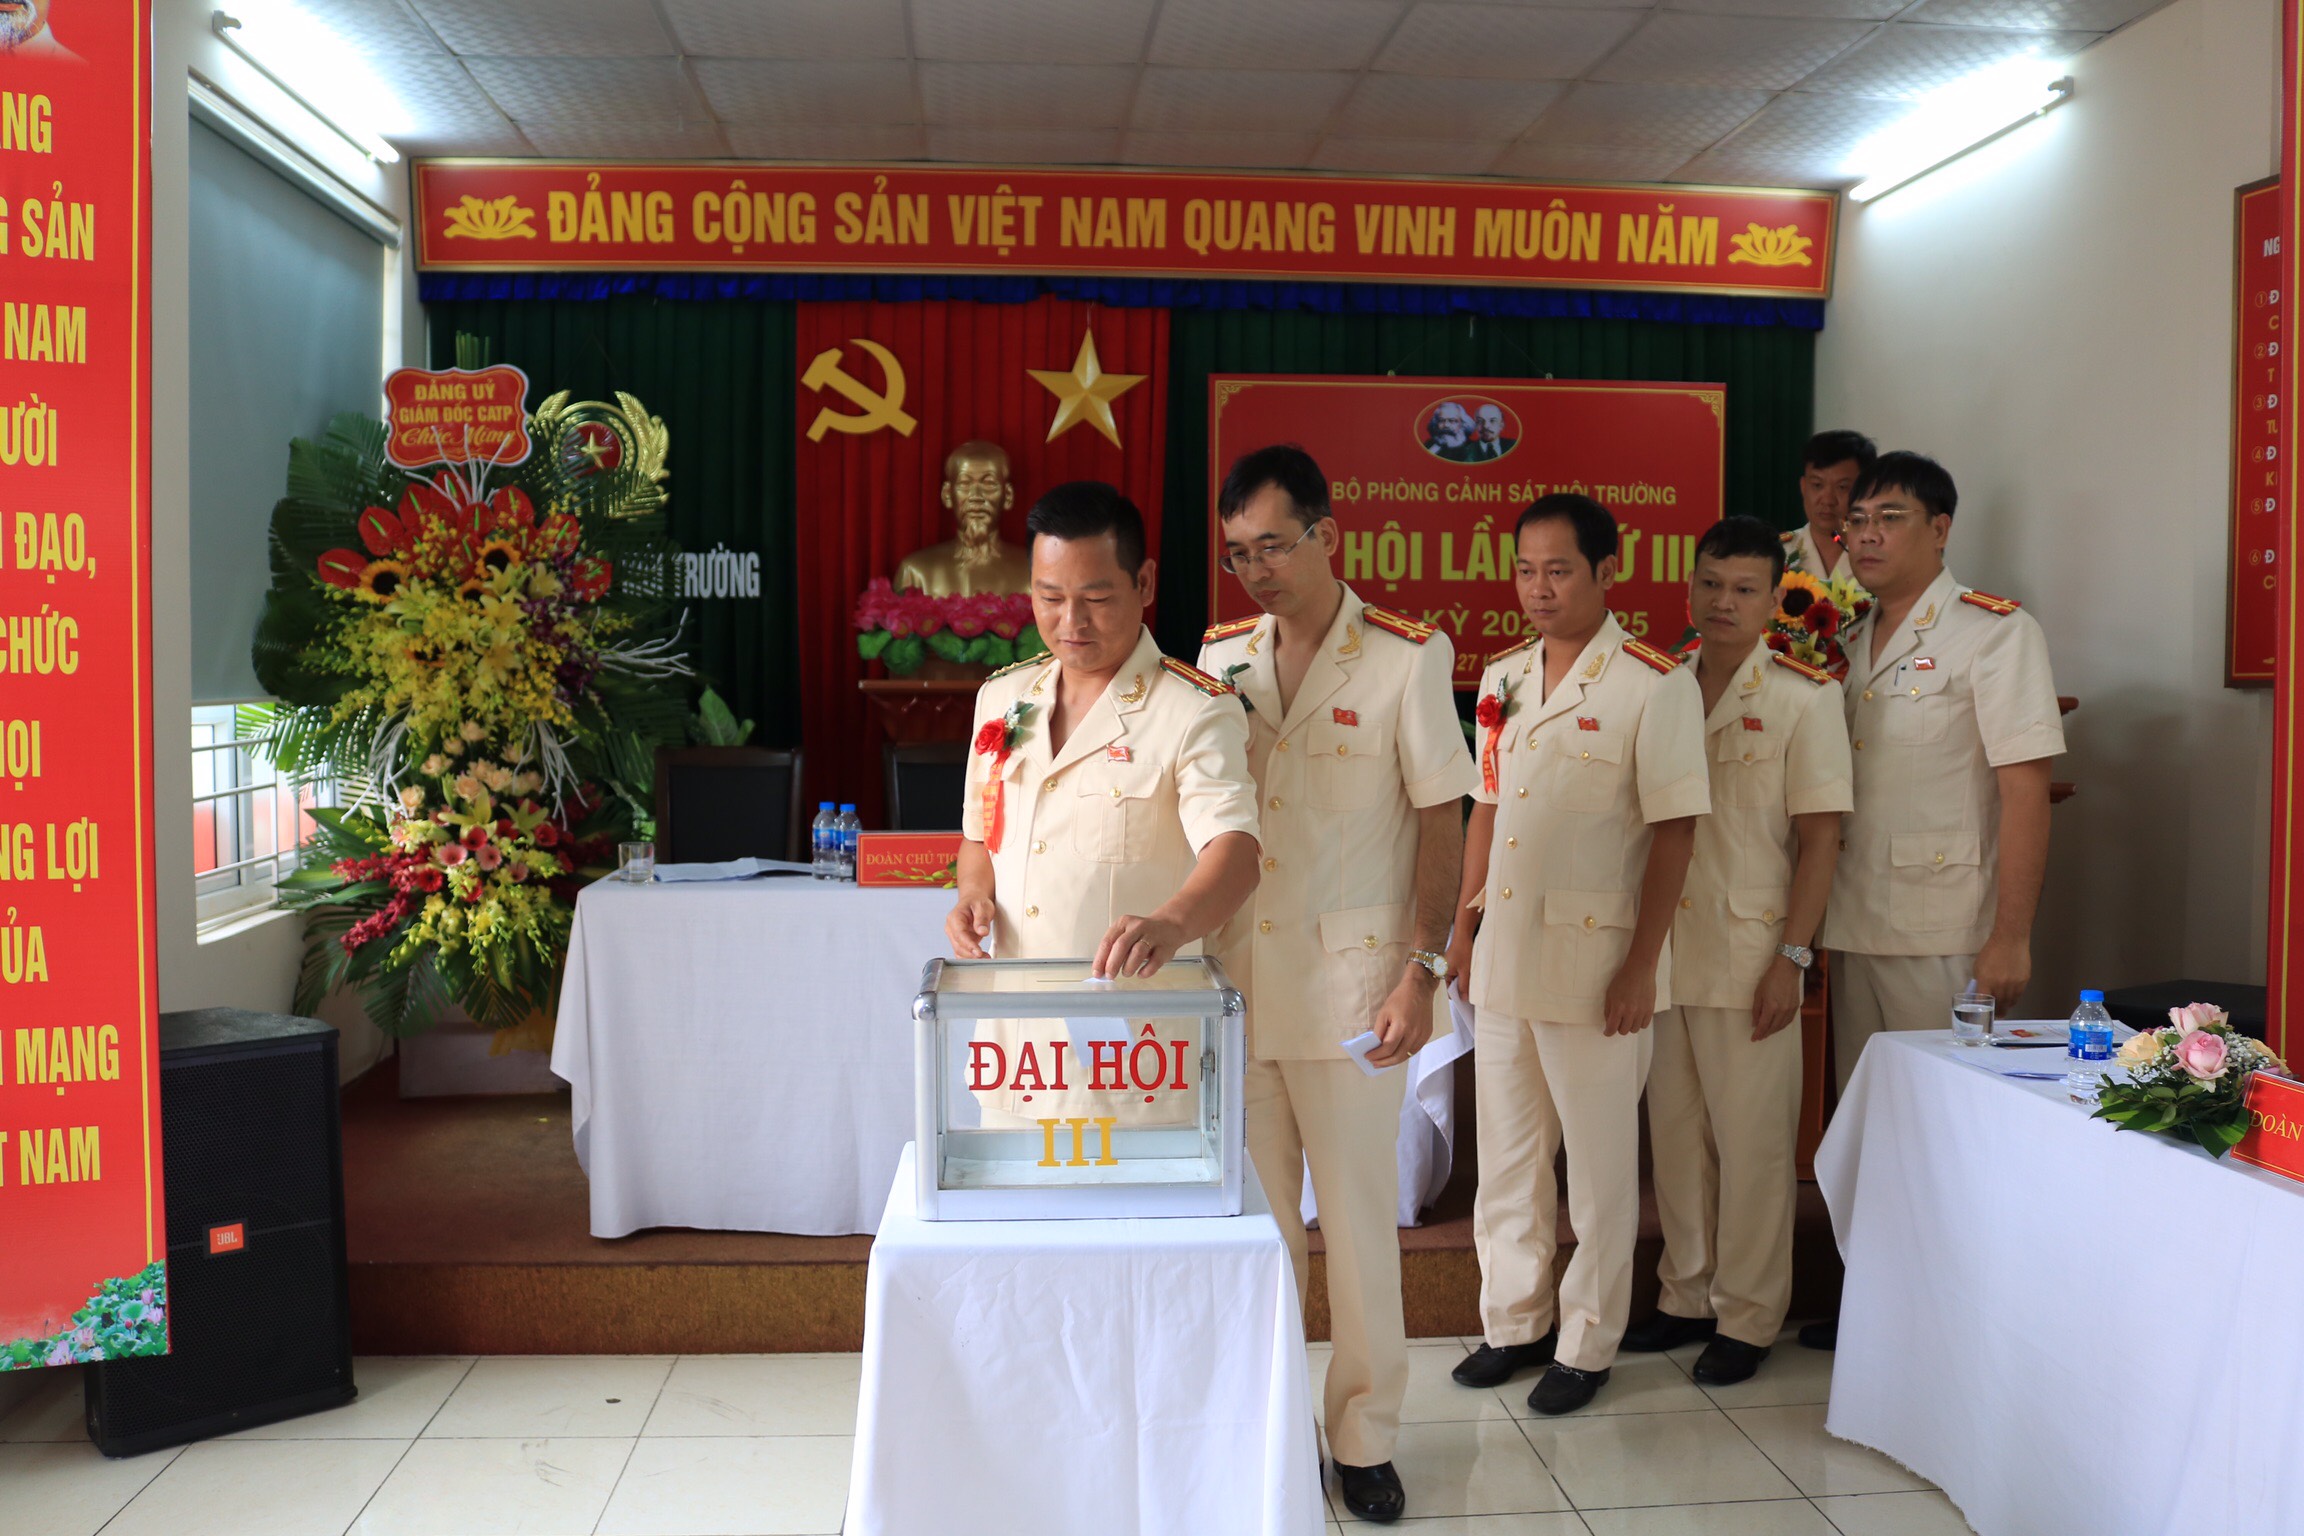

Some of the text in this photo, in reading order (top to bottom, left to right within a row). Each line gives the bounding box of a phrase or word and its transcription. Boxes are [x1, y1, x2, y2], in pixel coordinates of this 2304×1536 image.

[0, 91, 52, 153] NG
[21, 180, 95, 262] SẢN
[547, 172, 1719, 265] ĐẢNG CỘNG SẢN VIỆT NAM QUANG VINH MUÔN NĂM
[4, 301, 86, 364] NAM
[400, 400, 513, 424] GIÁM ĐỐC CATP
[414, 378, 467, 400] ĐẢNG
[1331, 477, 1361, 504] BỘ
[1367, 476, 1439, 502] PHÒNG
[1446, 475, 1501, 503] CẢNH
[1508, 479, 1546, 502] SÁT
[1595, 480, 1676, 505] TRƯỜNG
[14, 511, 96, 584] ĐẠO,
[1344, 520, 1423, 591] HỘI
[1651, 534, 1696, 583] III
[1482, 610, 1540, 637] 202
[1457, 653, 1478, 672] 27
[0, 719, 41, 791] ỌI
[46, 816, 99, 893] LỢI
[866, 850, 902, 865] ĐOÀN
[906, 850, 934, 865] CHỦ
[15, 1024, 120, 1096] MẠNG
[968, 1023, 1190, 1104] ĐẠI HỘI
[19, 1125, 101, 1186] NAM
[1036, 1117, 1119, 1167] III
[2250, 1109, 2304, 1141] ĐOÀN
[217, 1231, 238, 1246] JBL
